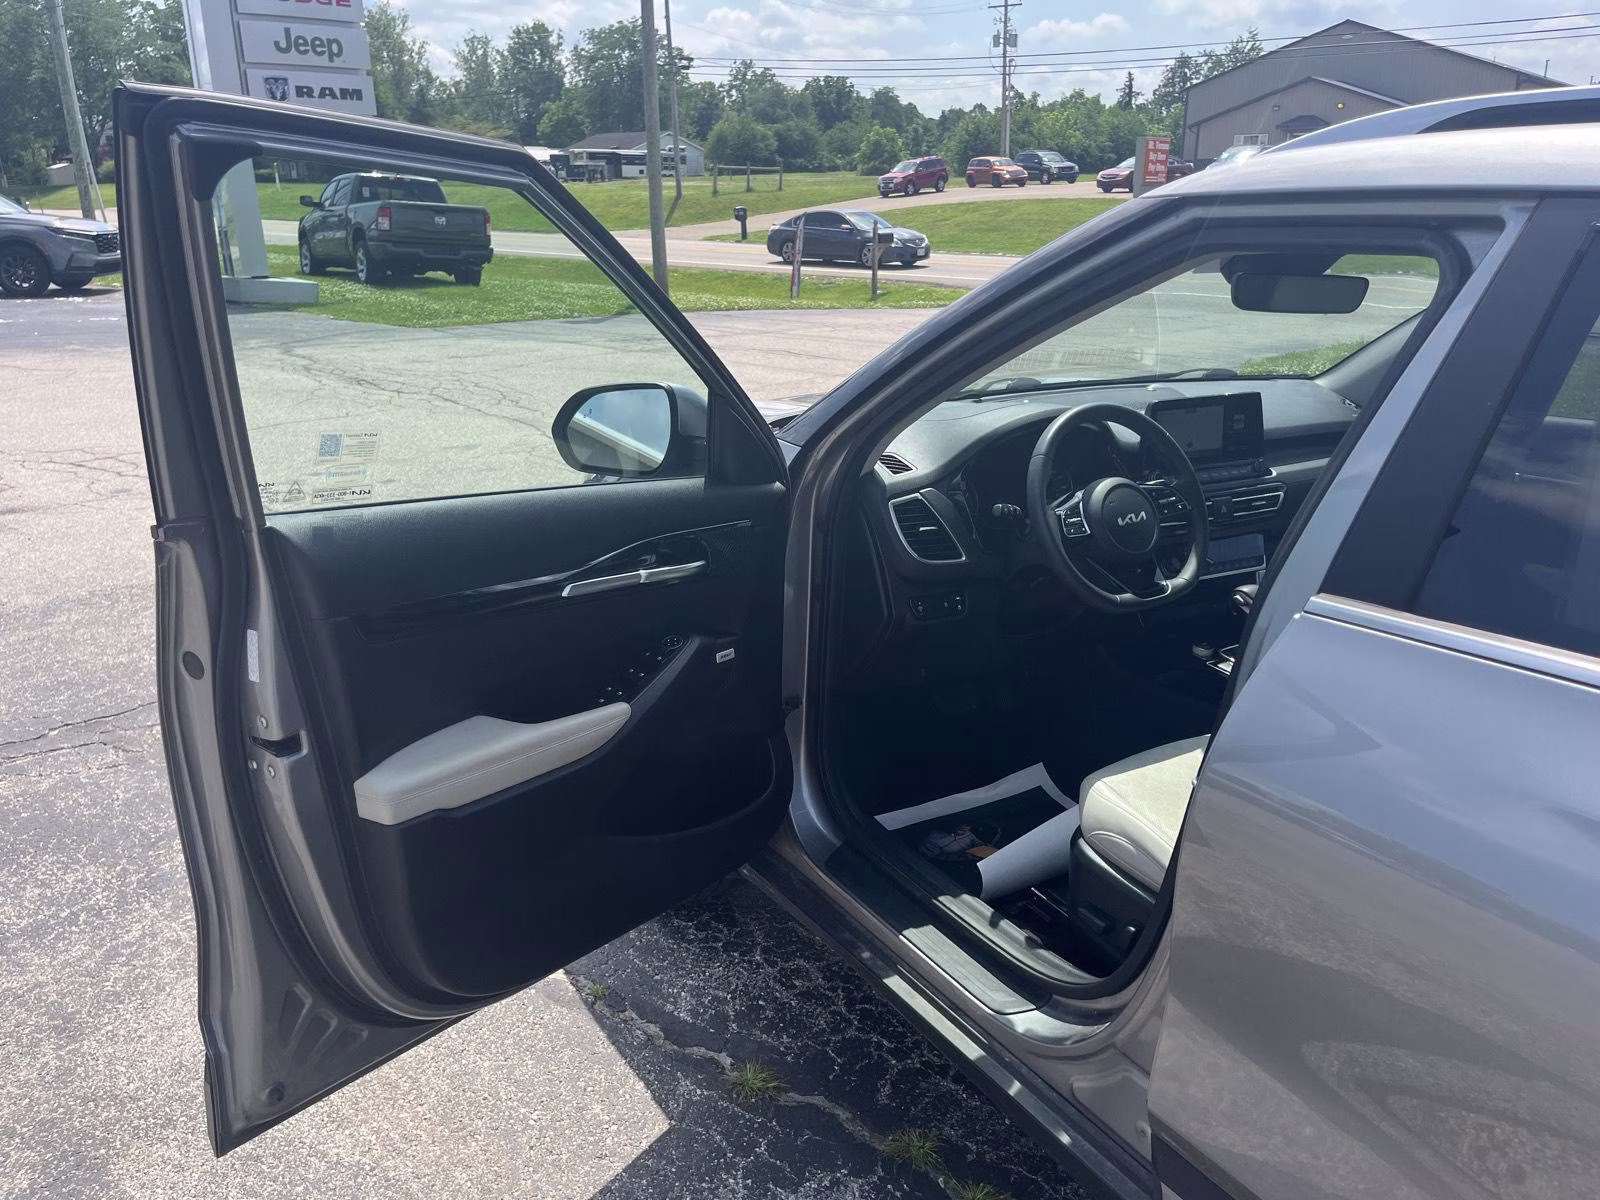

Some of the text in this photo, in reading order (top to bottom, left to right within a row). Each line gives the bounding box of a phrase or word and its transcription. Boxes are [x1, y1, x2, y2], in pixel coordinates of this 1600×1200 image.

[273, 27, 344, 63] Jeep
[294, 85, 363, 101] RAM
[1117, 511, 1147, 526] KIA
